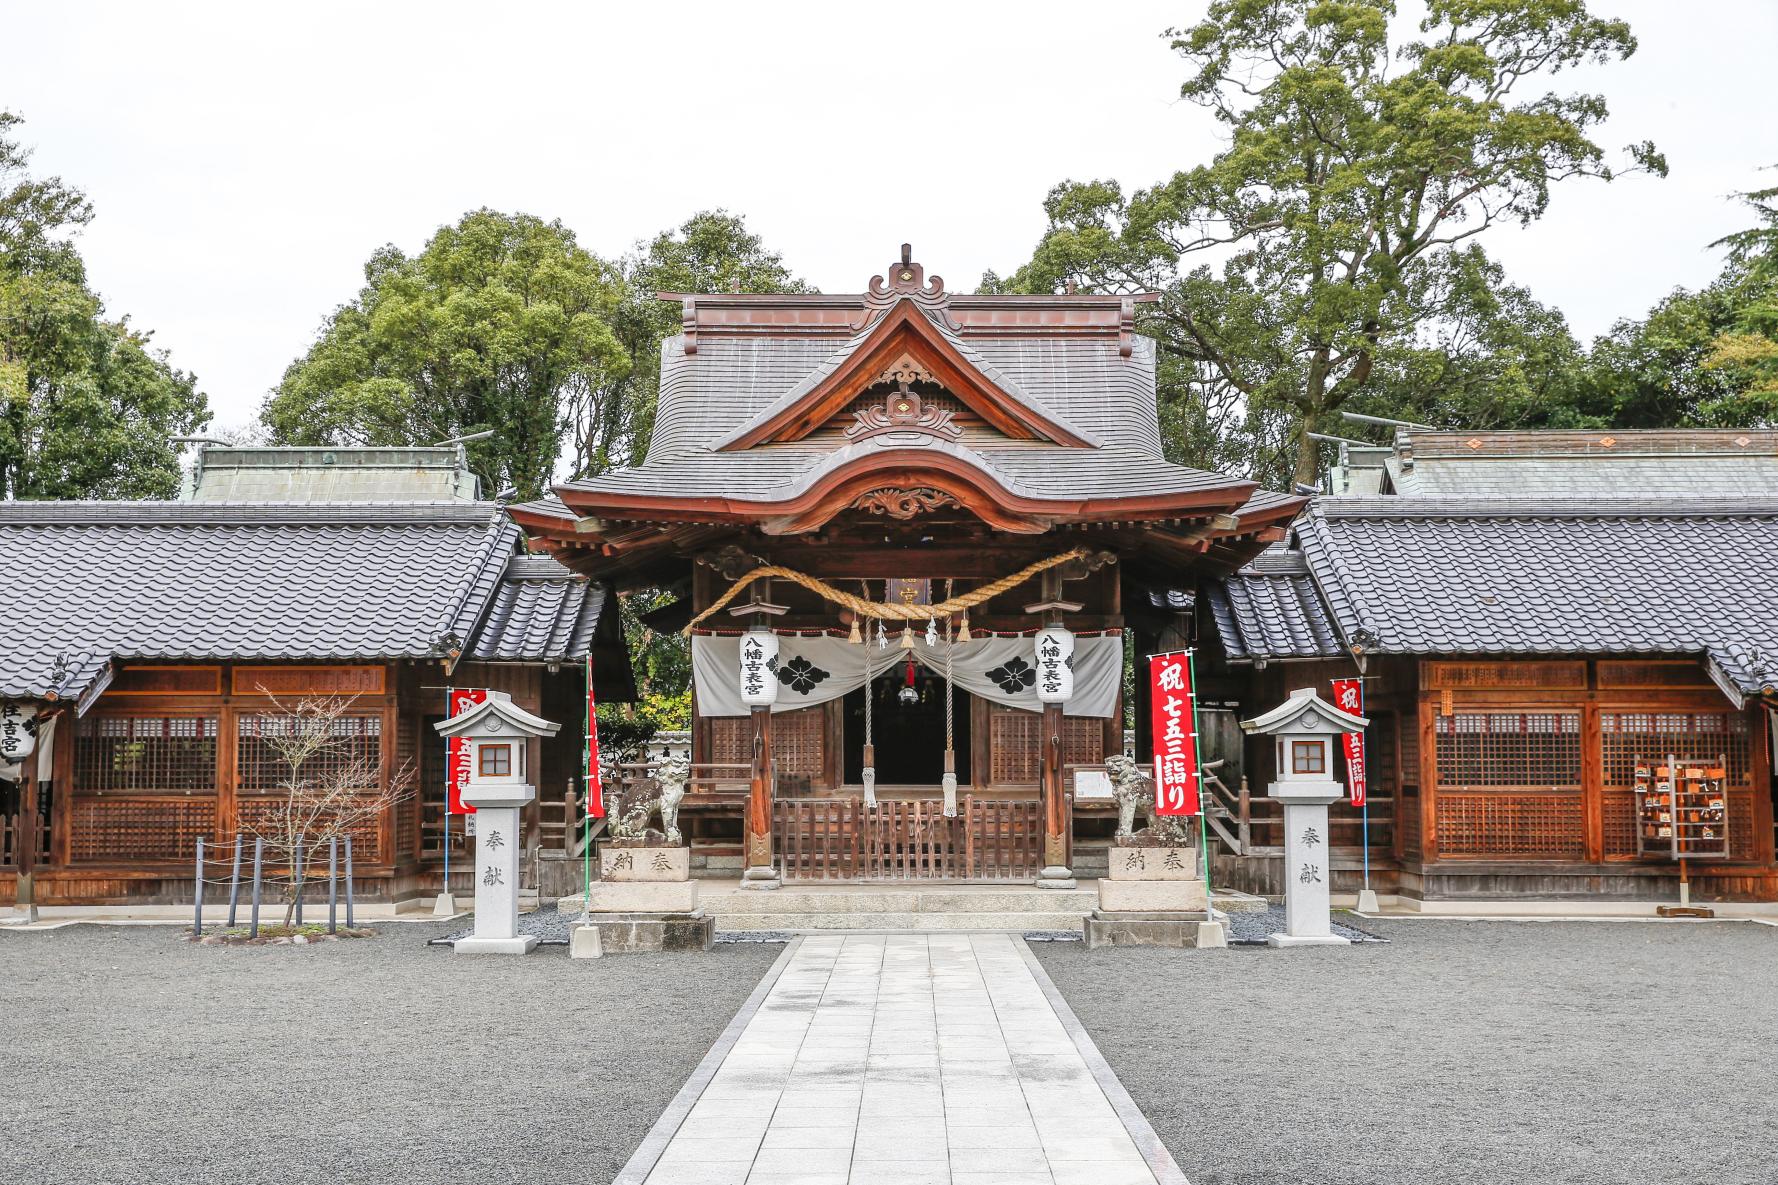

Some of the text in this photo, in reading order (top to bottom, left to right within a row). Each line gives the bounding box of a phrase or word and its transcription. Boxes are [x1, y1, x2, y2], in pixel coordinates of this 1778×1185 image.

[744, 637, 764, 696] 八幡古表宮
[1041, 634, 1062, 693] 八幡古表宮
[1, 703, 22, 752] 住吉宮
[1341, 684, 1363, 802] 祝五三詣り
